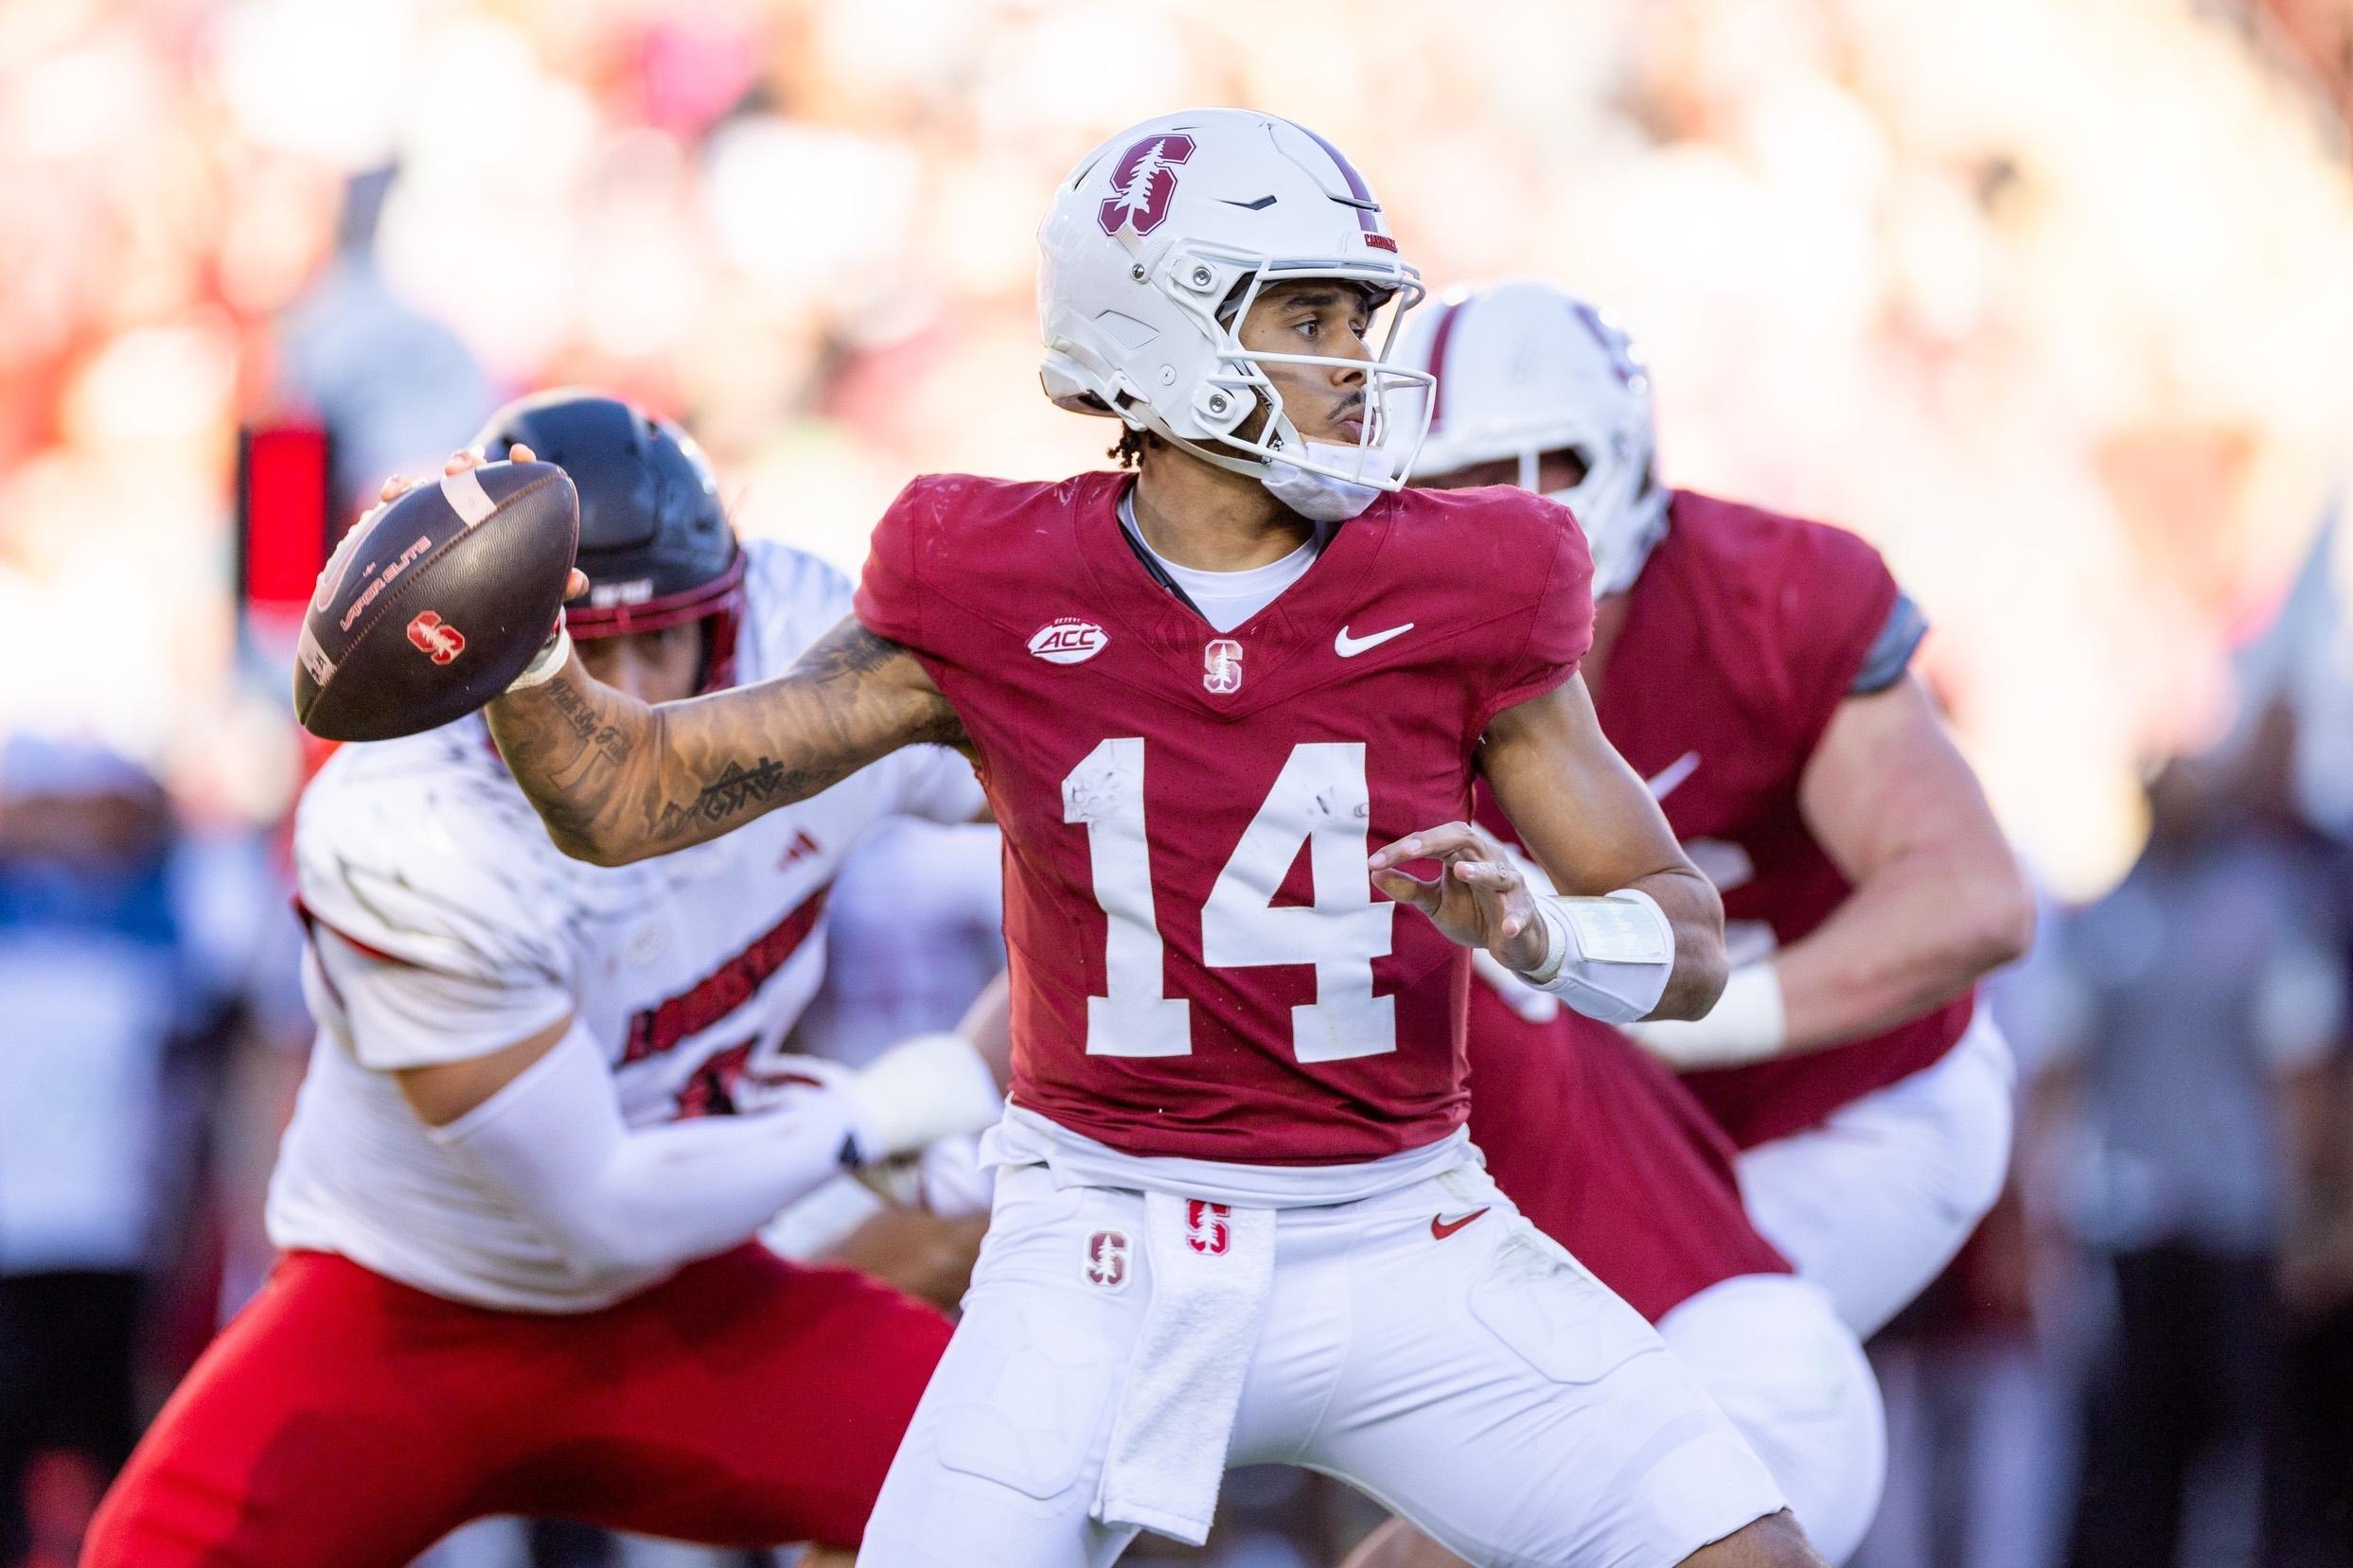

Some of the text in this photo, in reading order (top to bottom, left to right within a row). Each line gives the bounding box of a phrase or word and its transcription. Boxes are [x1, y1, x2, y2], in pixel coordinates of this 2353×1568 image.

[1097, 133, 1196, 237] S
[339, 536, 433, 632] VAPOR ELITE
[1038, 627, 1098, 649] ACC
[1061, 737, 1397, 1064] 14
